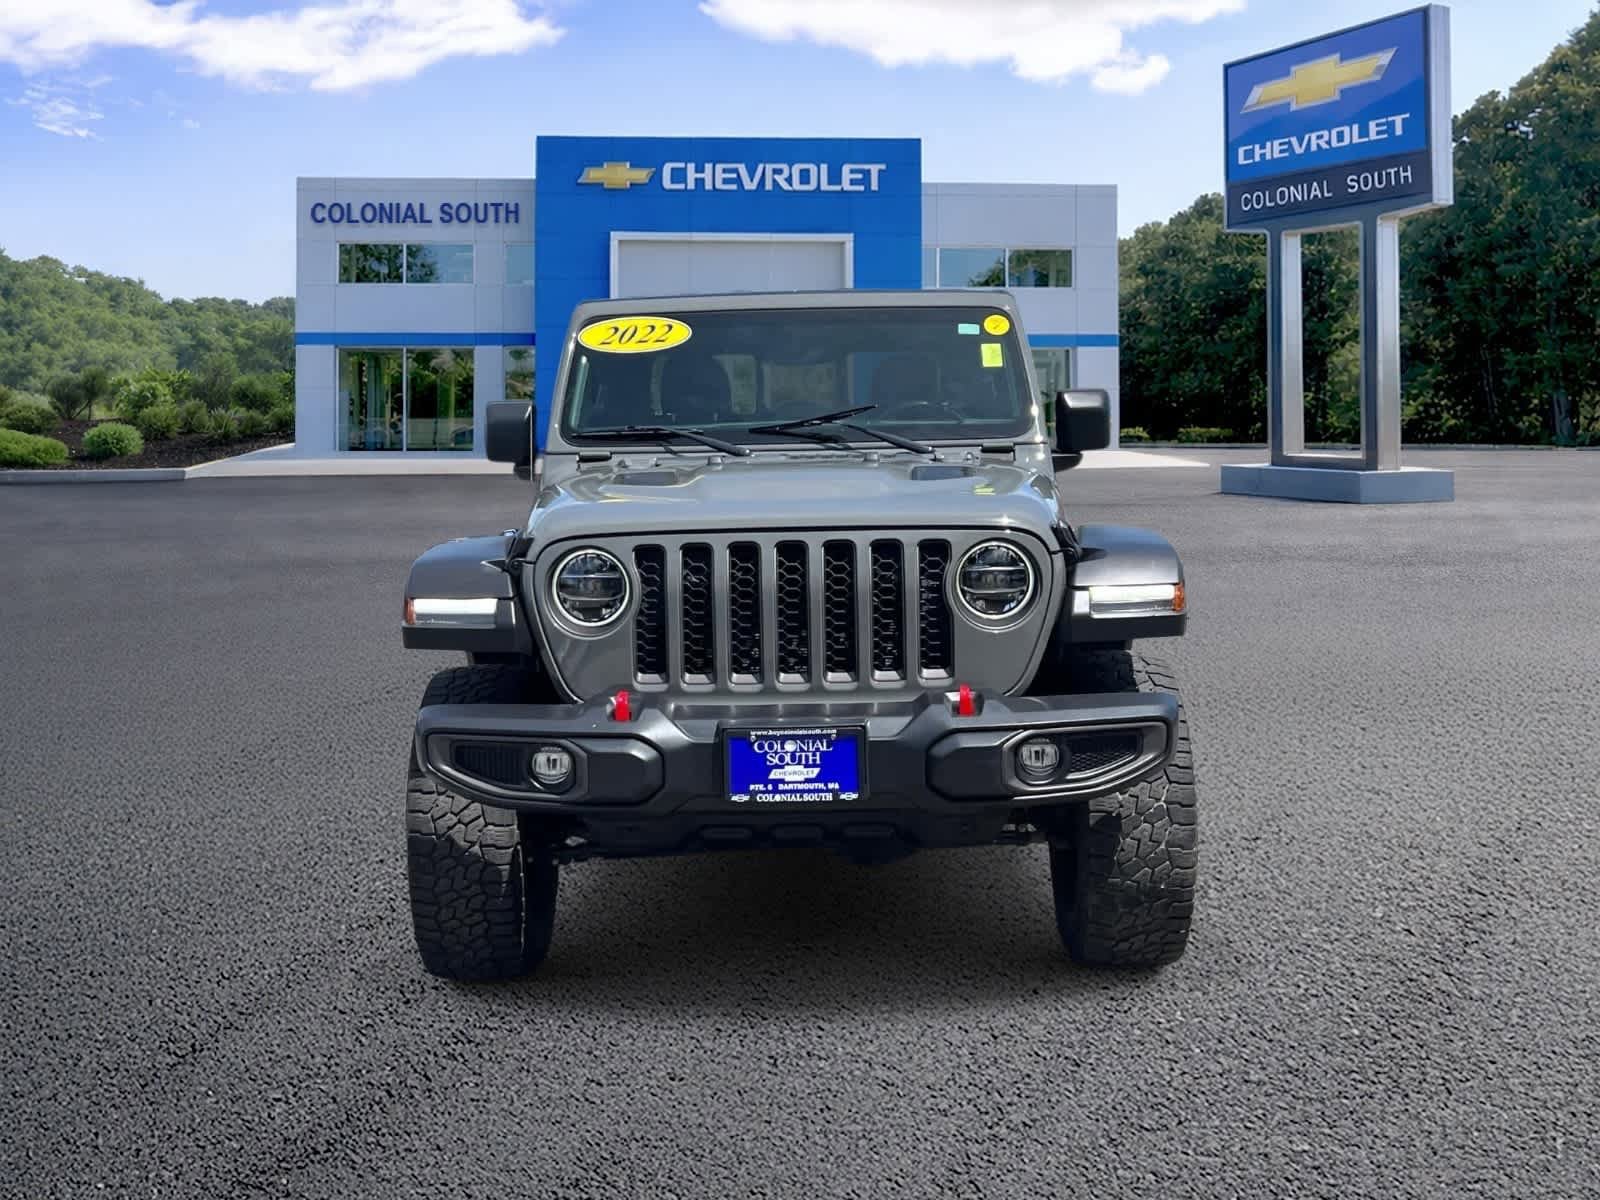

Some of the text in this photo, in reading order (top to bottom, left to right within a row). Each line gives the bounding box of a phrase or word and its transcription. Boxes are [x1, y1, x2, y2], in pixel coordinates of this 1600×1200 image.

[1237, 112, 1411, 165] CHEVROLET
[662, 161, 887, 192] CHEVROLET
[1240, 164, 1413, 212] COLONIAL SOUTH
[310, 202, 520, 225] COLONIAL SOUTH
[597, 323, 673, 346] 2022
[754, 740, 832, 753] COLONIAL
[766, 752, 820, 765] SOUTH
[773, 769, 815, 777] CHEVROLET
[756, 792, 833, 801] COLONIAL SOUTH
